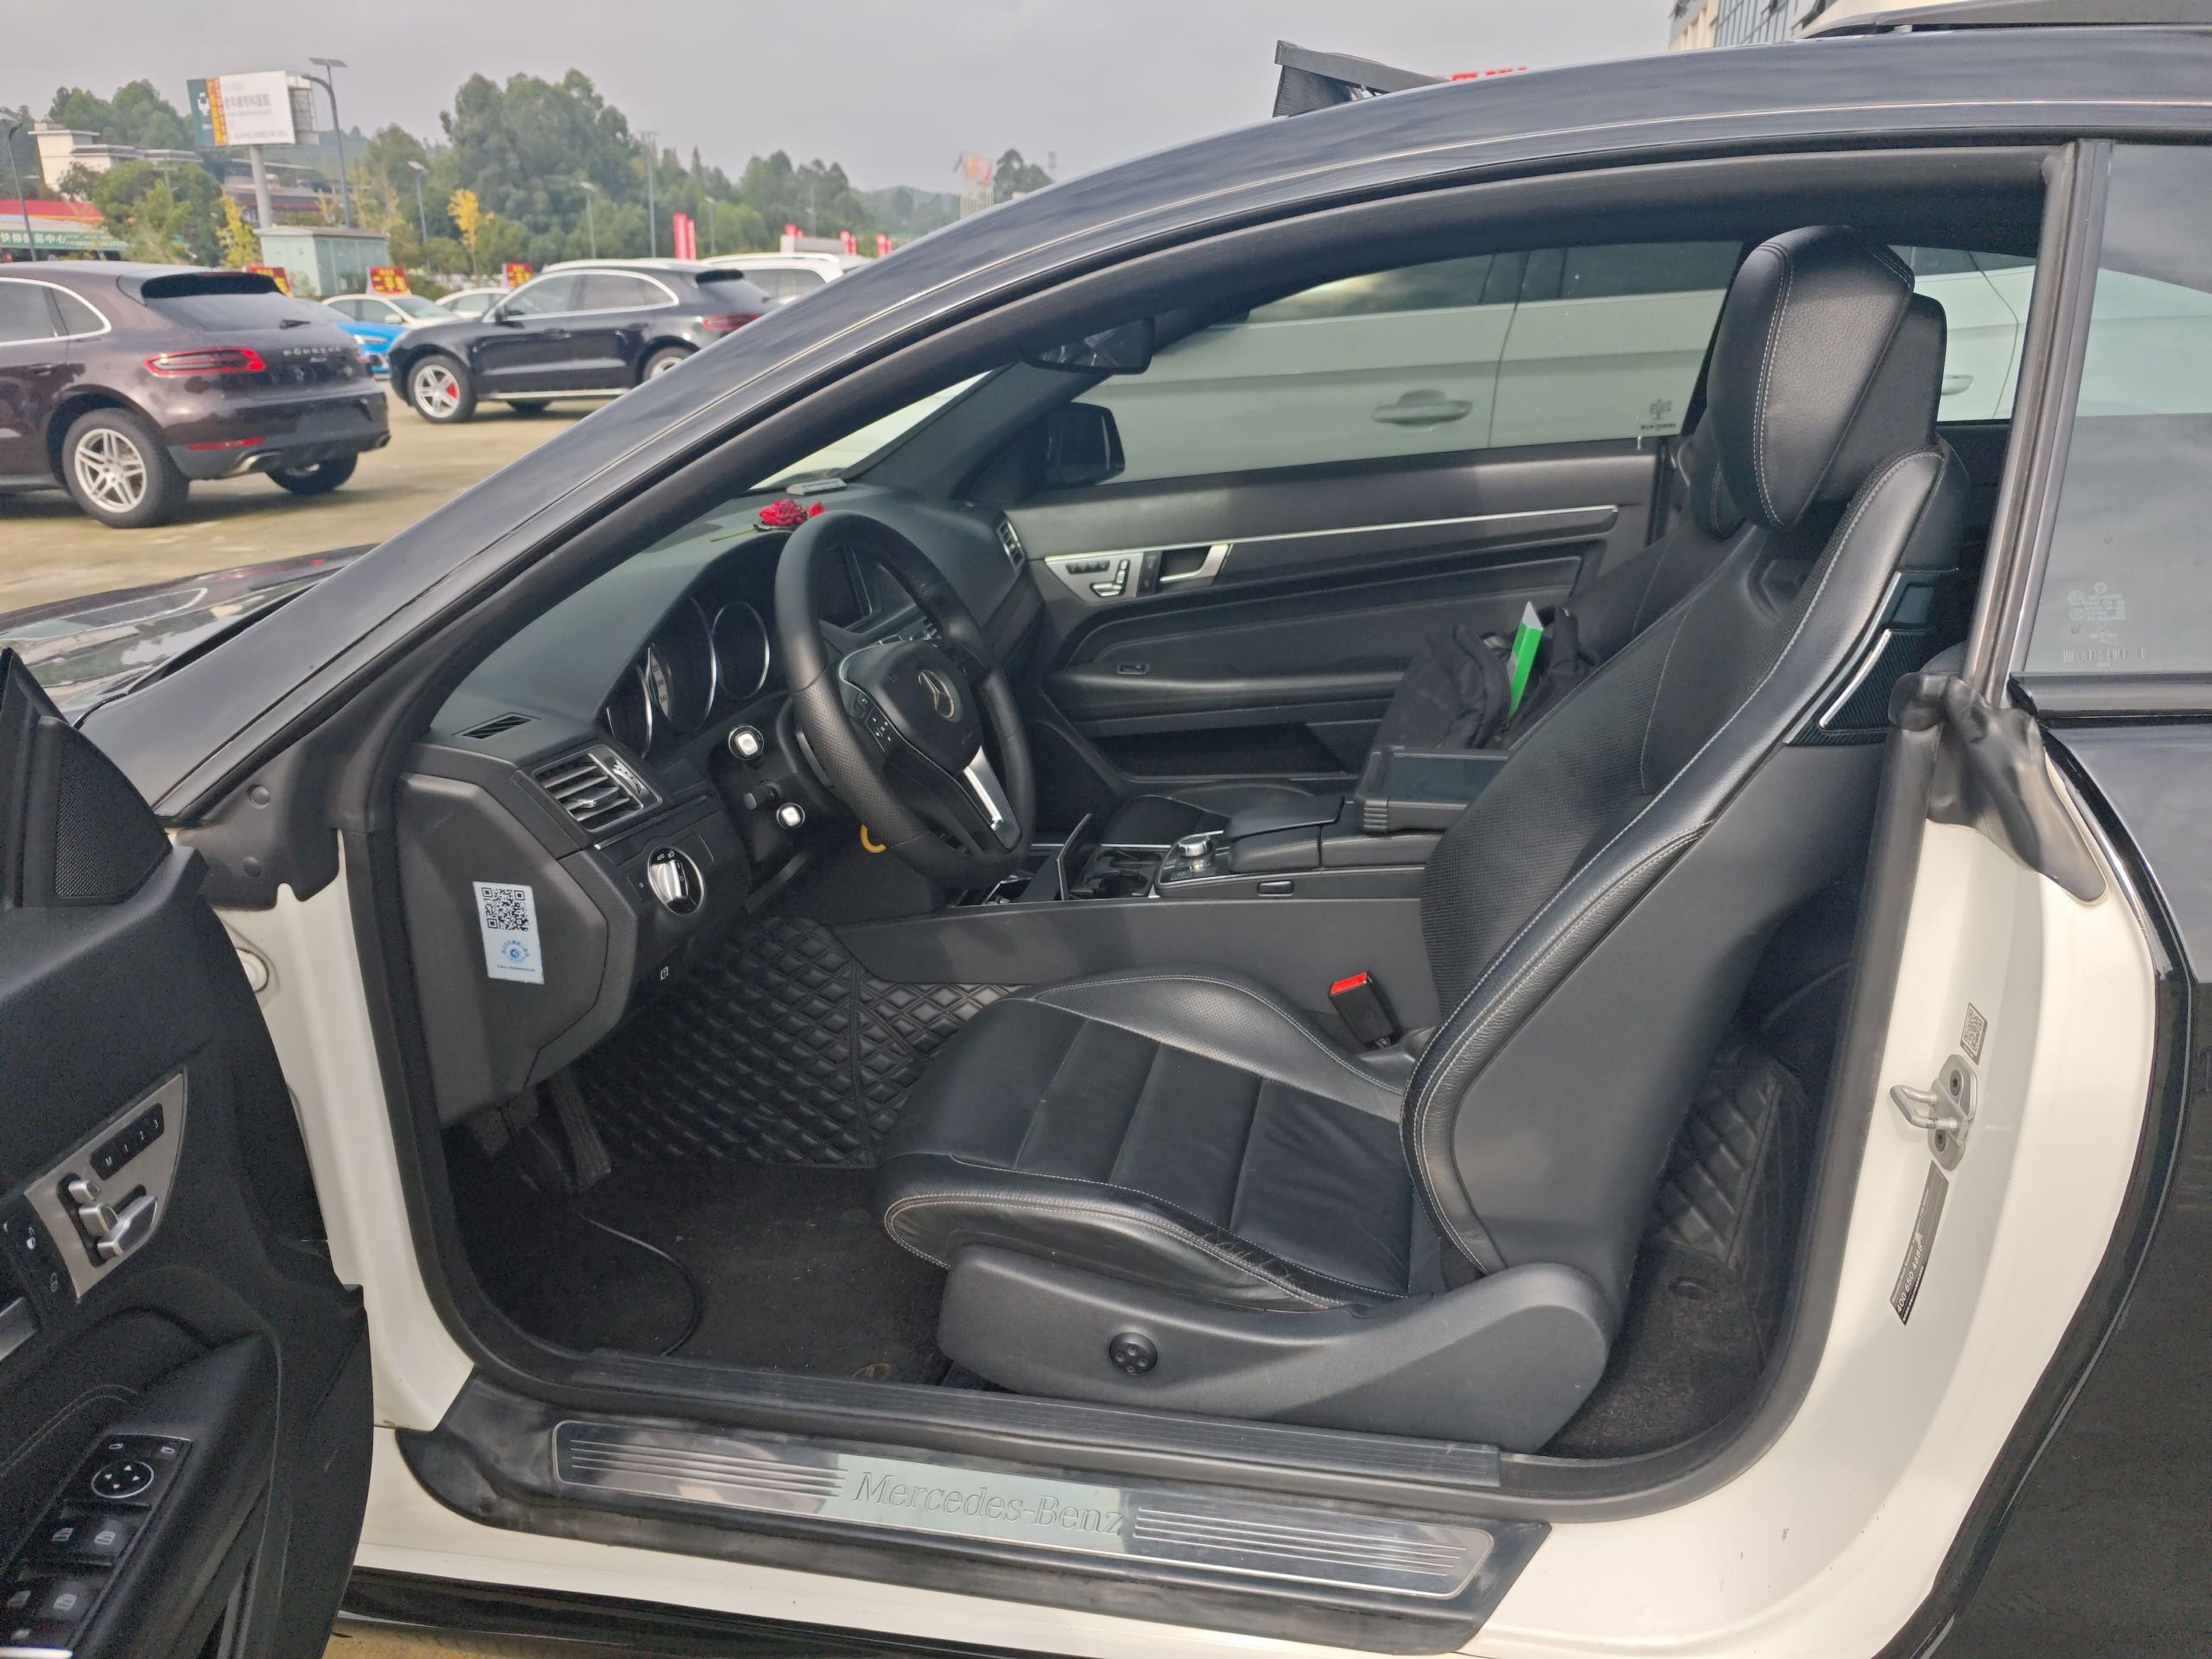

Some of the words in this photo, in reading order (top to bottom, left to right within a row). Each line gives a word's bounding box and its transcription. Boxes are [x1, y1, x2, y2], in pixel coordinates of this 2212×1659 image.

[105, 1156, 112, 1167] M
[124, 1144, 128, 1152] 1
[140, 1131, 145, 1141] 2
[154, 1119, 158, 1128] 3
[1897, 1292, 1907, 1313] 400
[1905, 1271, 1914, 1291] 650
[853, 1472, 1124, 1536] Mercedes-Benz
